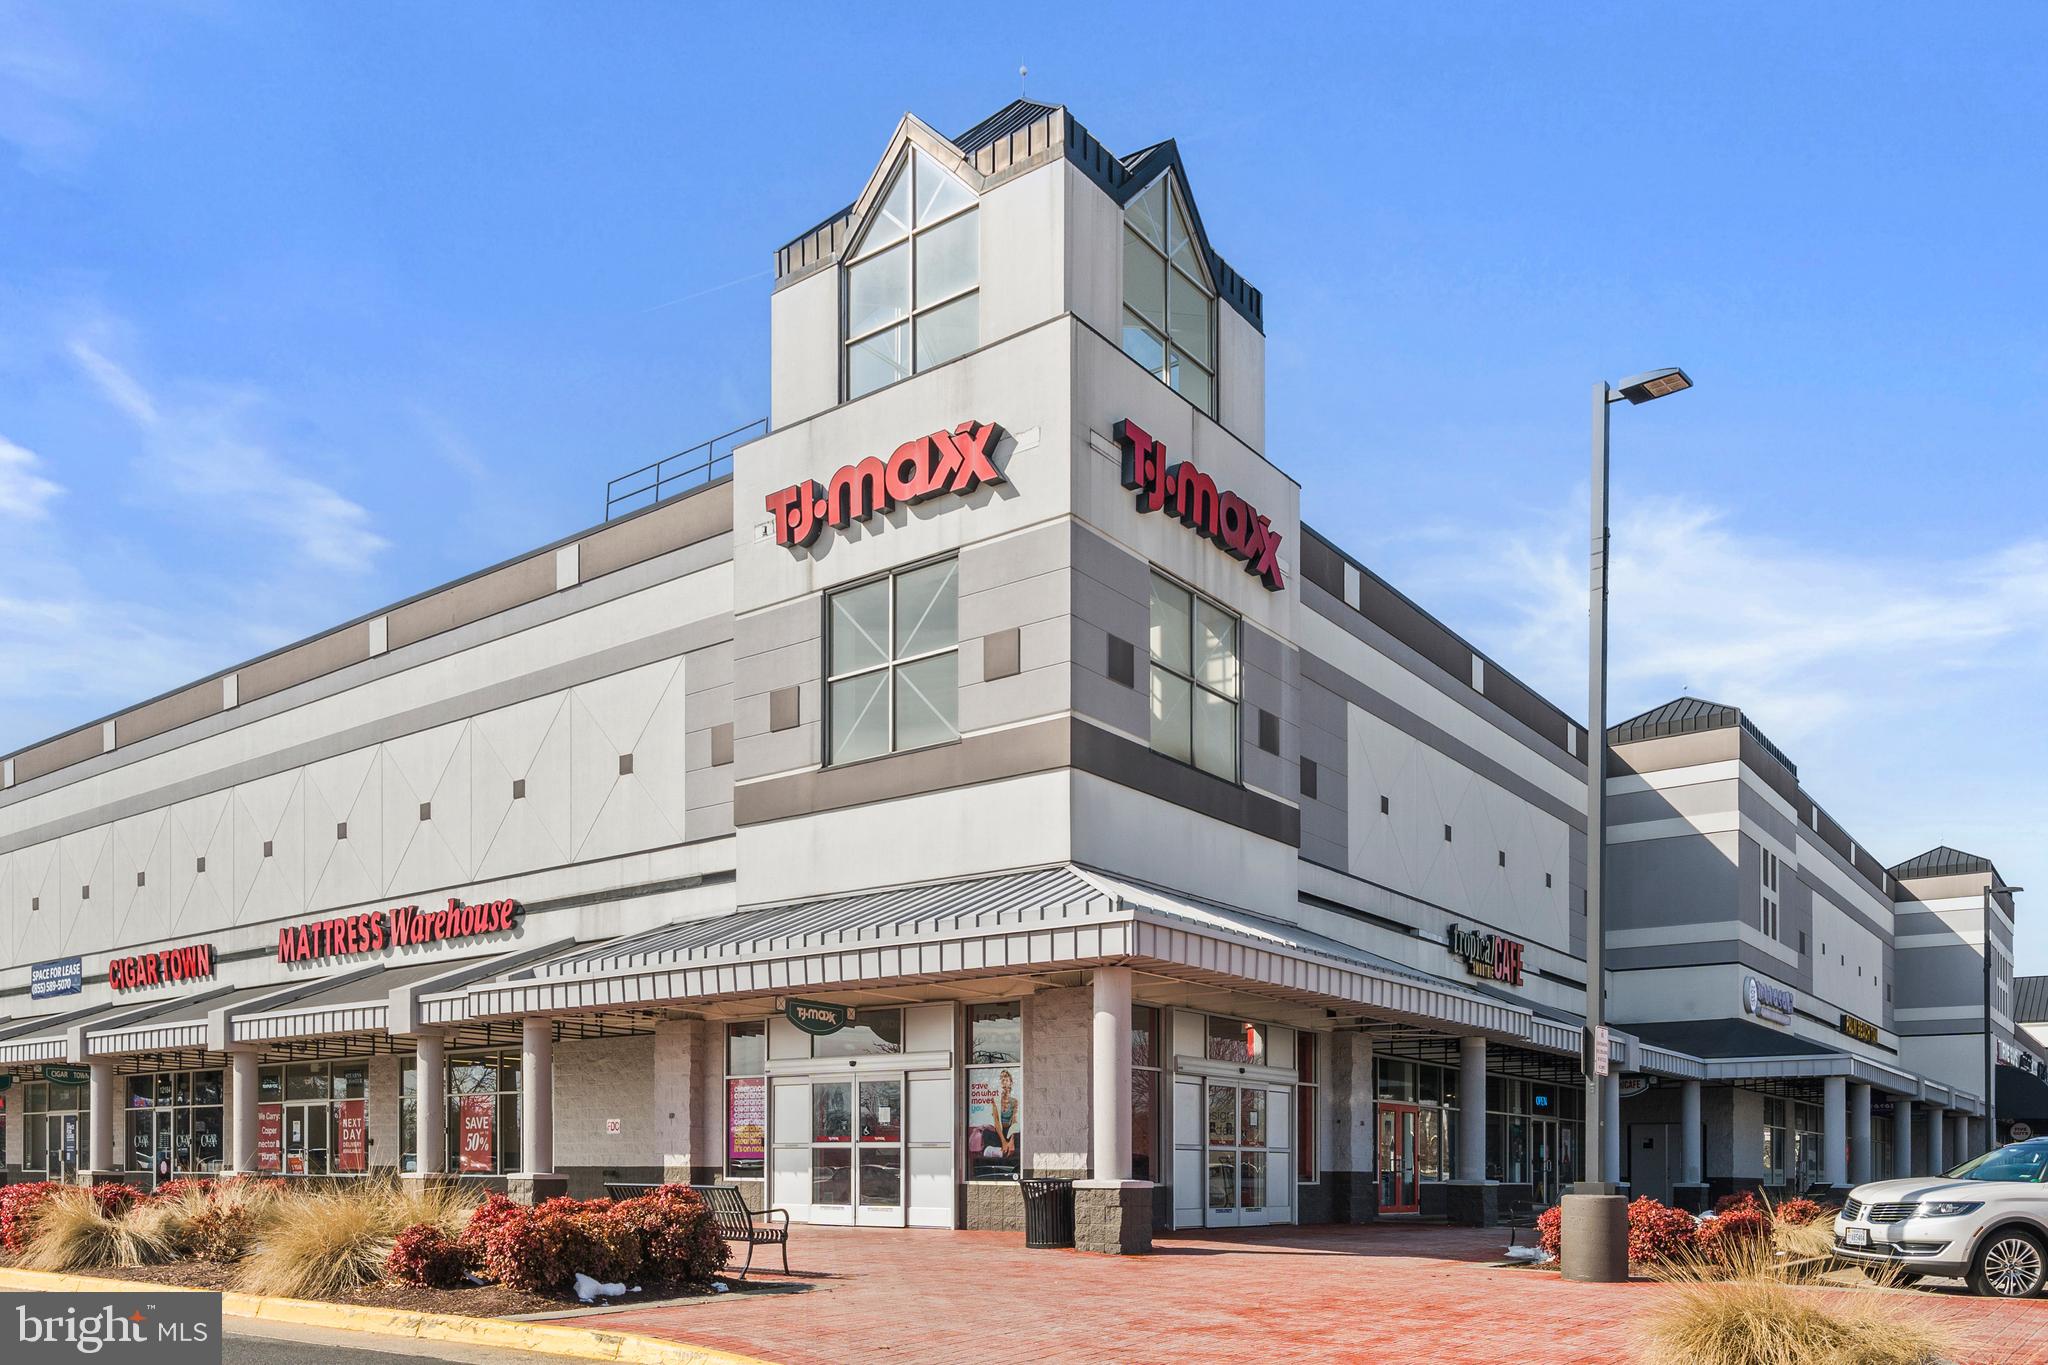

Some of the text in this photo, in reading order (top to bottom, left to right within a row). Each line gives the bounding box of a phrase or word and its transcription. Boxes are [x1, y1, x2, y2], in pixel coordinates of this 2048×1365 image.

[278, 898, 516, 963] MATTRESS Warehouse
[1452, 924, 1495, 964] tropical
[1494, 936, 1524, 986] CAFE
[32, 963, 80, 982] SPACE FOR LEASE
[109, 944, 212, 990] CIGAR TOWN
[32, 978, 71, 994] (855) 589-5070
[51, 1070, 68, 1078] CIGAR
[1624, 1079, 1640, 1089] CAFE
[982, 1089, 999, 1097] what
[1536, 1096, 1547, 1106] OPEN
[971, 1105, 985, 1114] you
[342, 1118, 361, 1128] NEXT
[465, 1116, 489, 1130] SAVE
[343, 1129, 361, 1140] DAY
[465, 1133, 489, 1152] 50%
